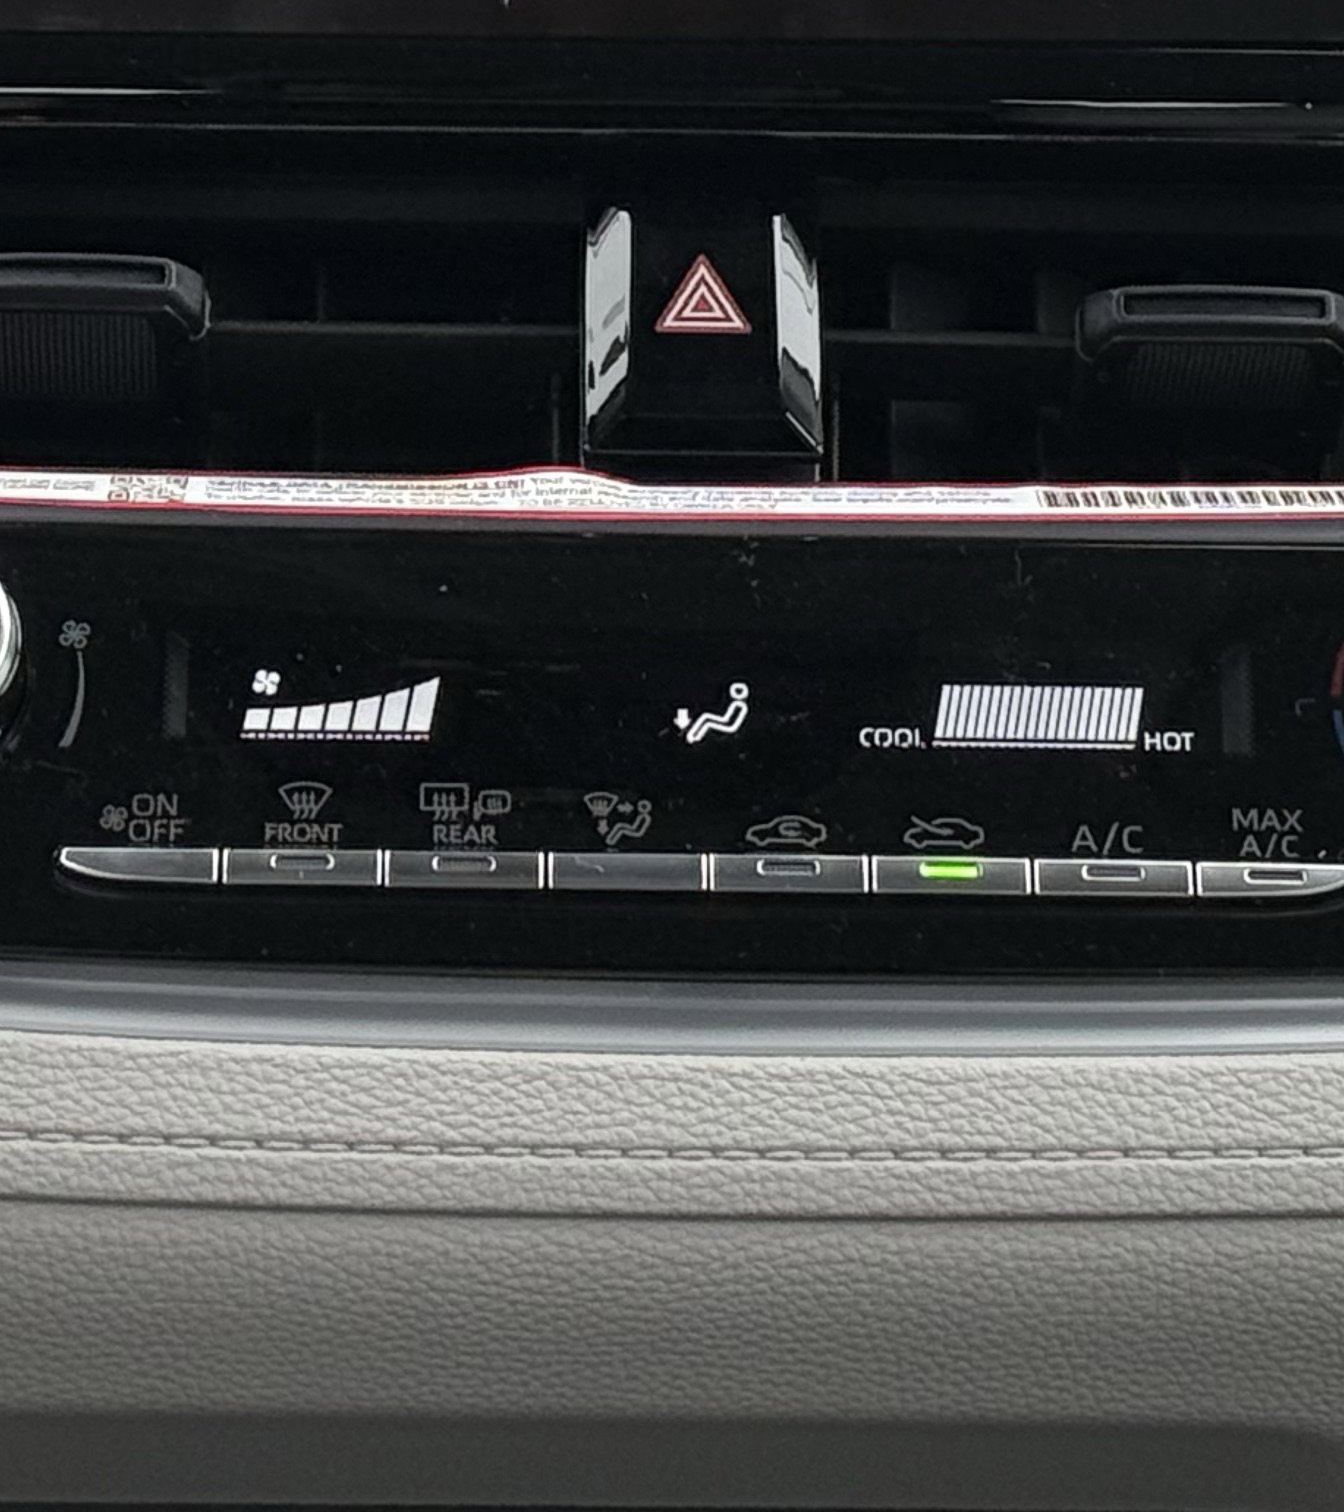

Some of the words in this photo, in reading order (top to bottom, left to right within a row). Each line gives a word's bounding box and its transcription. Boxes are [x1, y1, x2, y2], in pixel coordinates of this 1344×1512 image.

[859, 726, 926, 749] COOL
[1144, 731, 1195, 752] HOT
[132, 794, 178, 816] ON
[129, 819, 185, 842] OFF
[1232, 807, 1303, 833] MAX
[264, 823, 342, 843] FRONT
[432, 824, 497, 844] REAR
[1072, 824, 1144, 854] A/C
[1239, 834, 1299, 859] A/C
